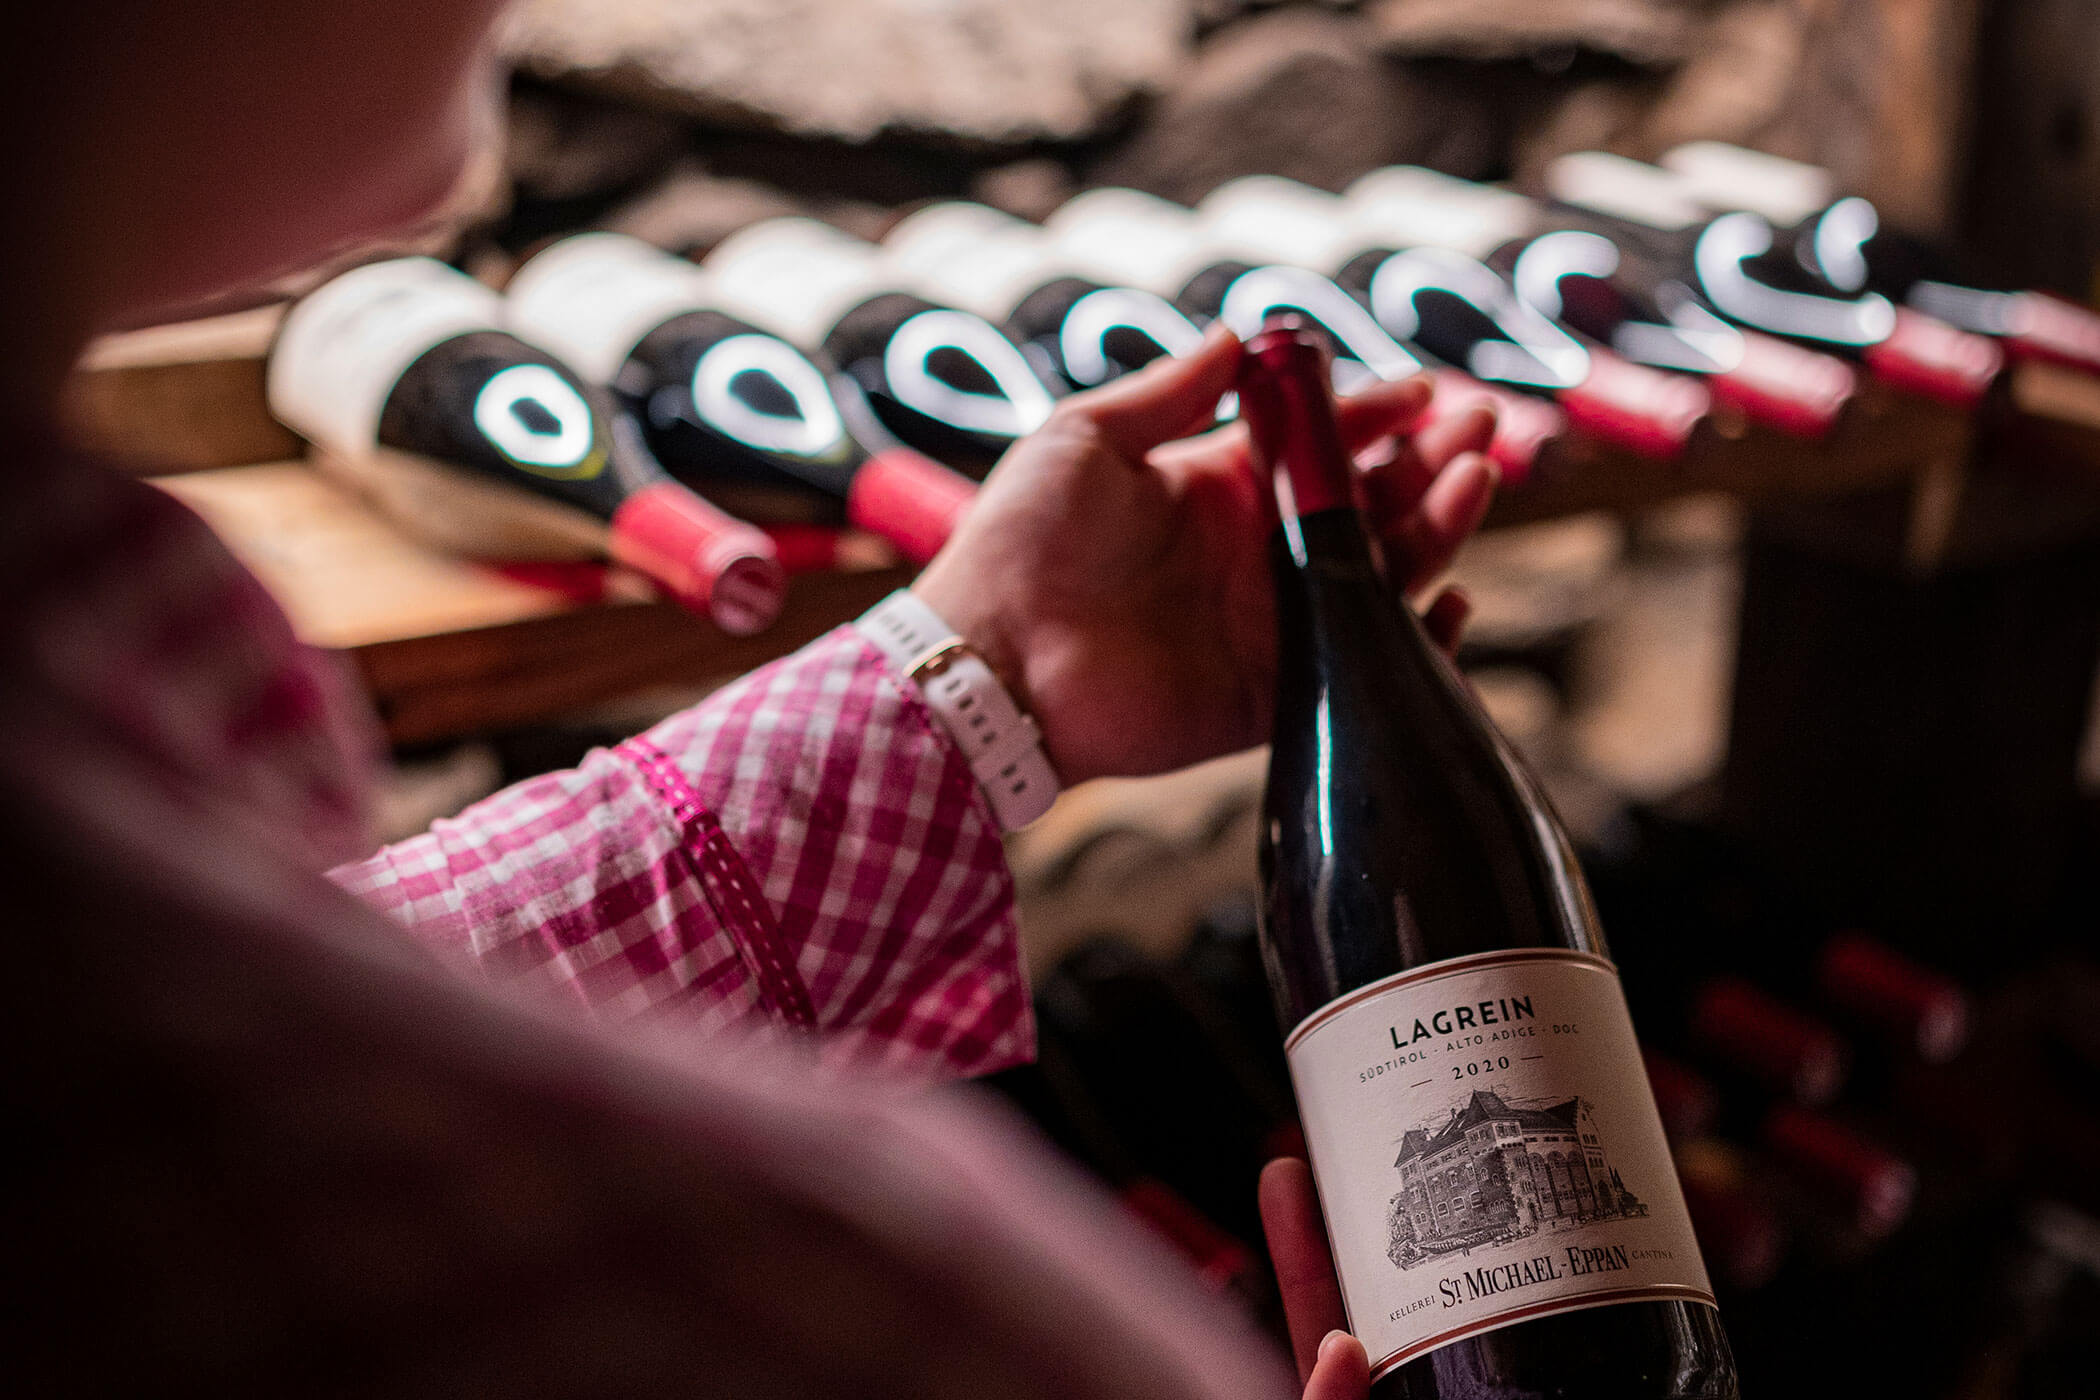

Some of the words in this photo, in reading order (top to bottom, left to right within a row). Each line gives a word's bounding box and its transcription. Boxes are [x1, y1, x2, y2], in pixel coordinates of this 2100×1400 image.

[1390, 996, 1535, 1049] LAGREIN
[1359, 1051, 1427, 1083] SÜDTIROL
[1446, 1035, 1483, 1052] ALTO
[1492, 1026, 1536, 1042] ADIGE
[1553, 1024, 1579, 1034] DOC
[1451, 1056, 1510, 1080] 2020
[1389, 1295, 1436, 1322] KELLEREI
[1632, 1249, 1675, 1260] CANTINA
